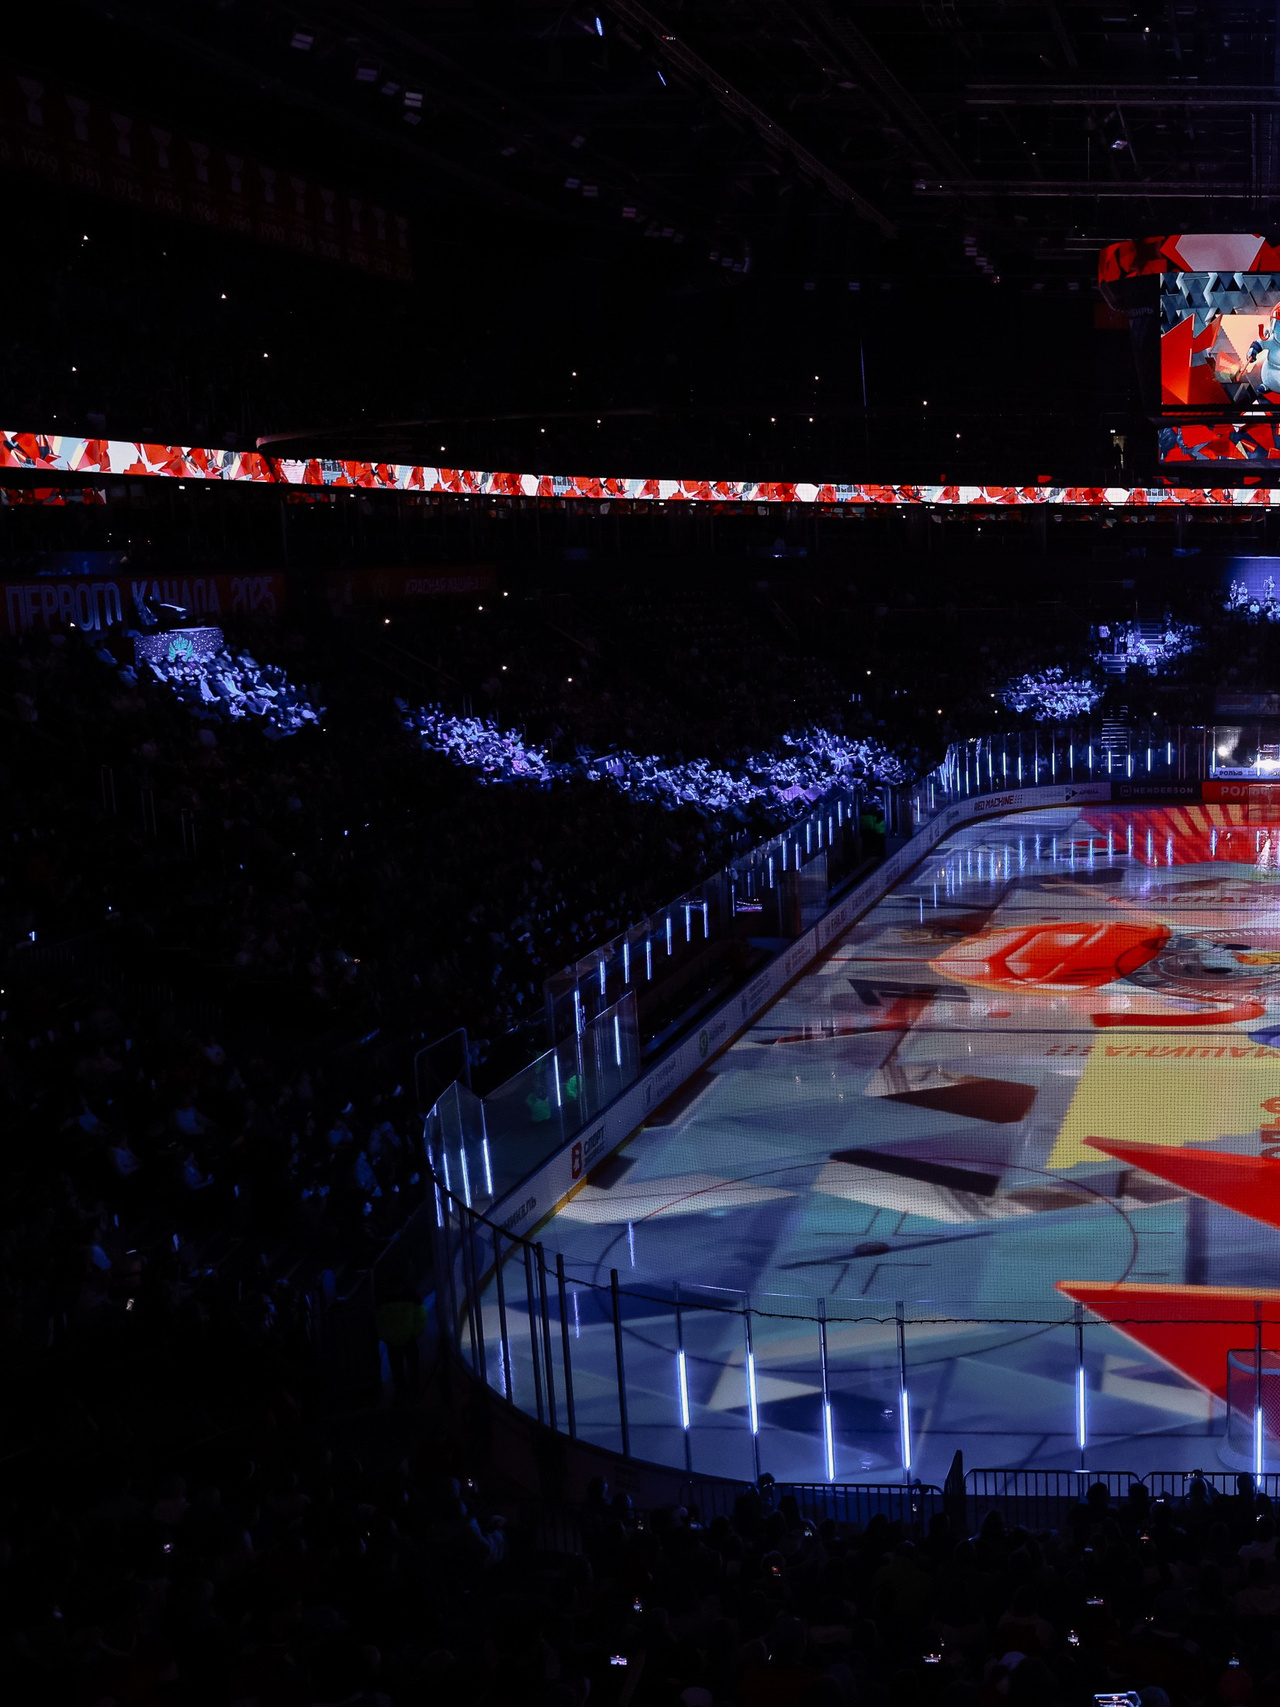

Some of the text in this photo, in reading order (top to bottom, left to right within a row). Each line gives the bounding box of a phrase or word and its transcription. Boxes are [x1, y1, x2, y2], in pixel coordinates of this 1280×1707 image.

[5, 581, 122, 637] ПЕРВОГО
[231, 575, 277, 616] 2025
[985, 795, 1015, 810] MACHINE
